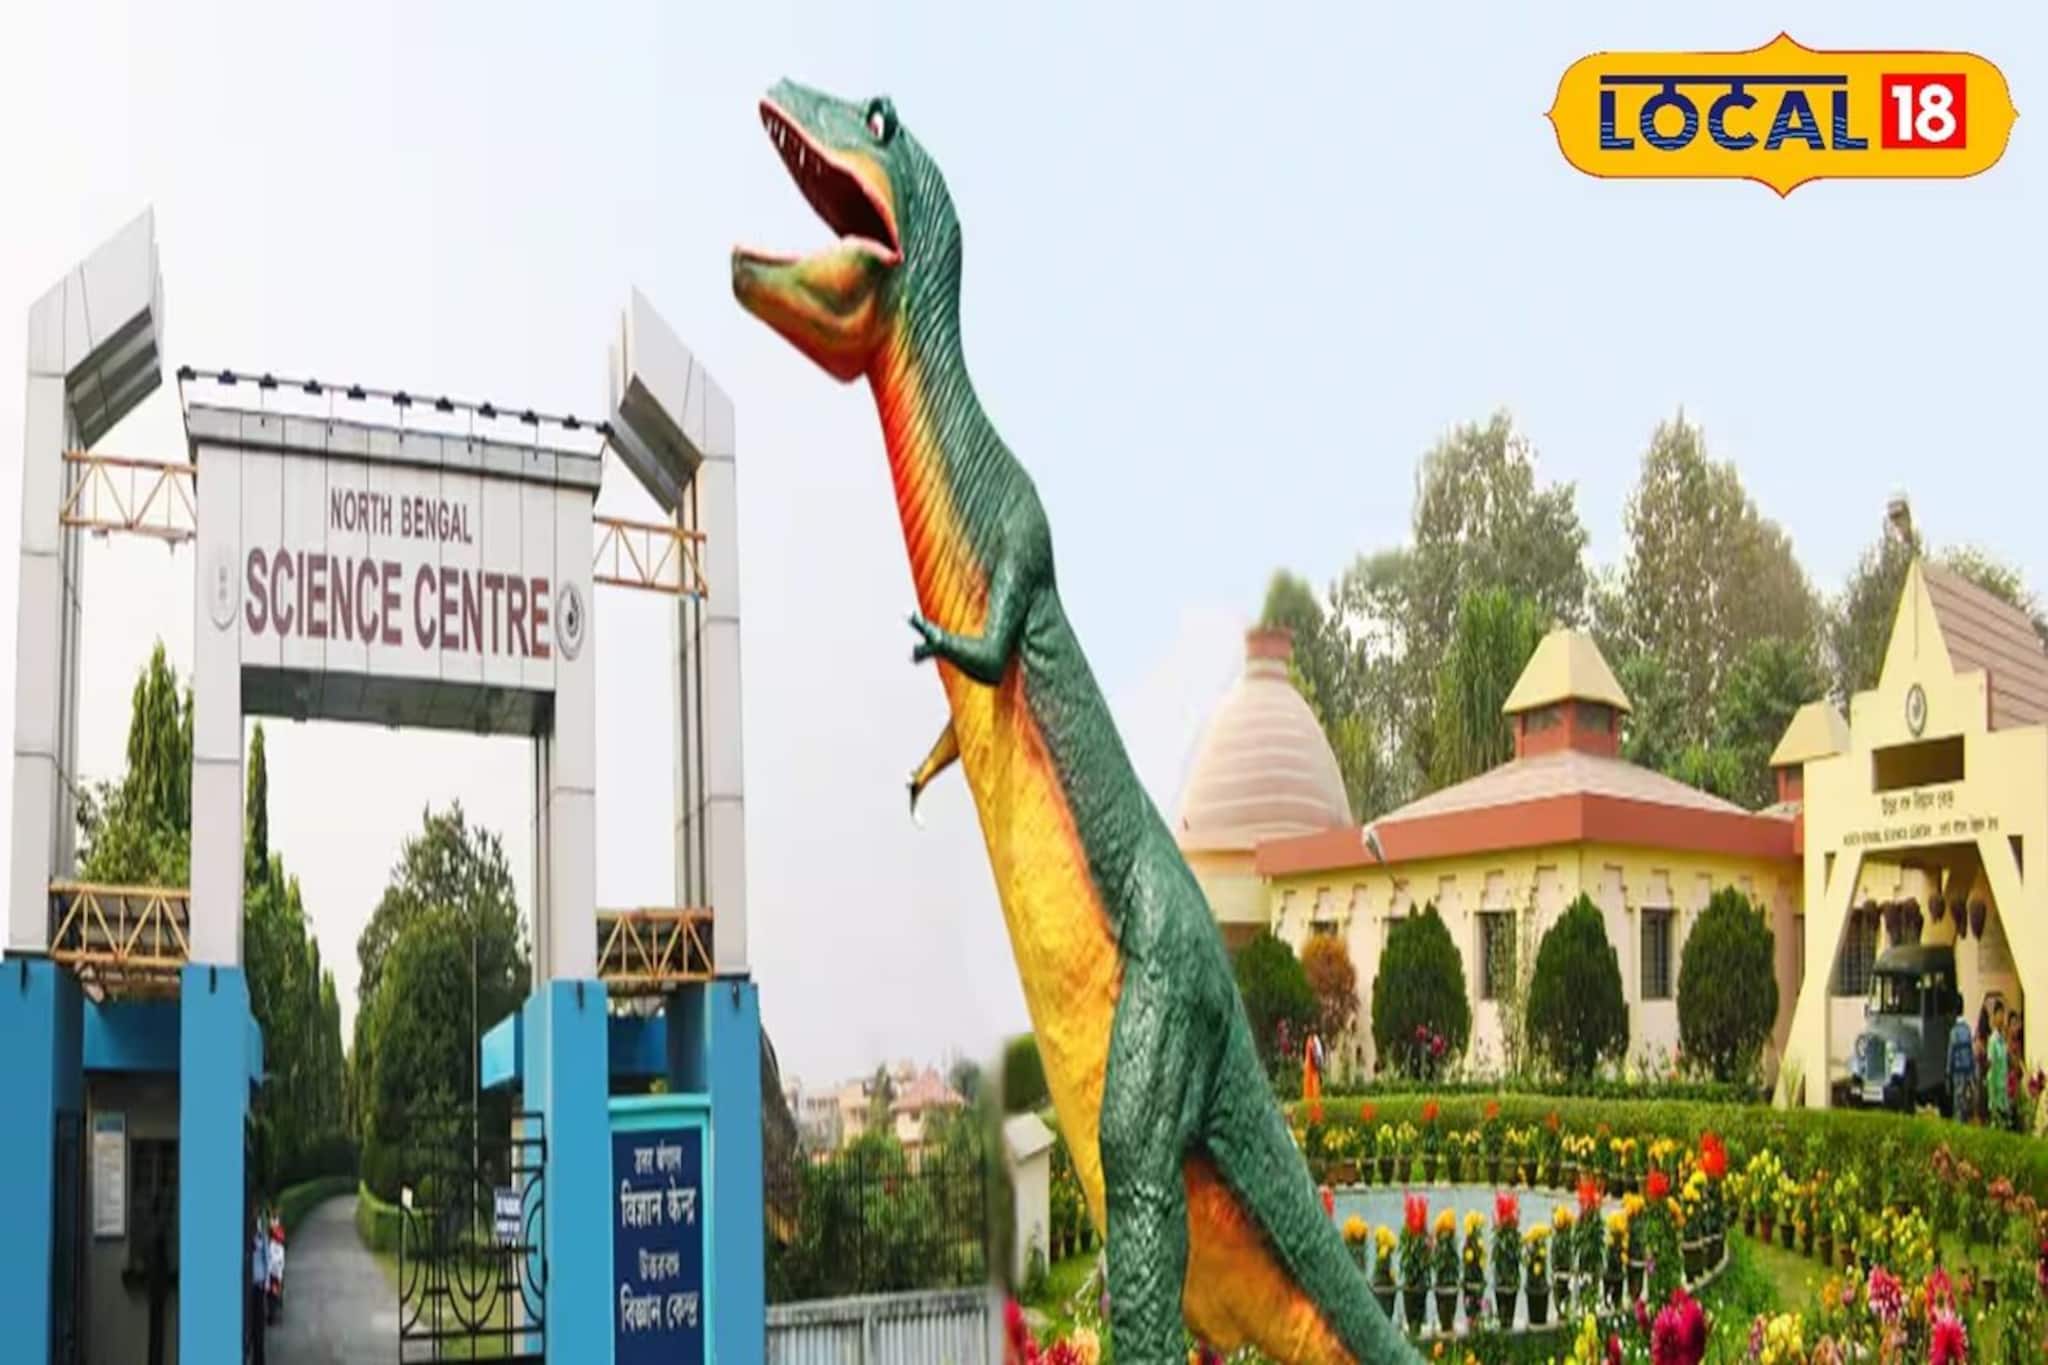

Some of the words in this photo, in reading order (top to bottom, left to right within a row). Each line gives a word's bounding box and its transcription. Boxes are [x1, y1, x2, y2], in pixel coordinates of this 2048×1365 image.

[331, 487, 393, 536] NORTH
[401, 498, 472, 545] BENGAL
[245, 546, 404, 647] SCIENCE
[414, 563, 551, 660] CENTRE
[621, 1178, 662, 1229] विज्ञान
